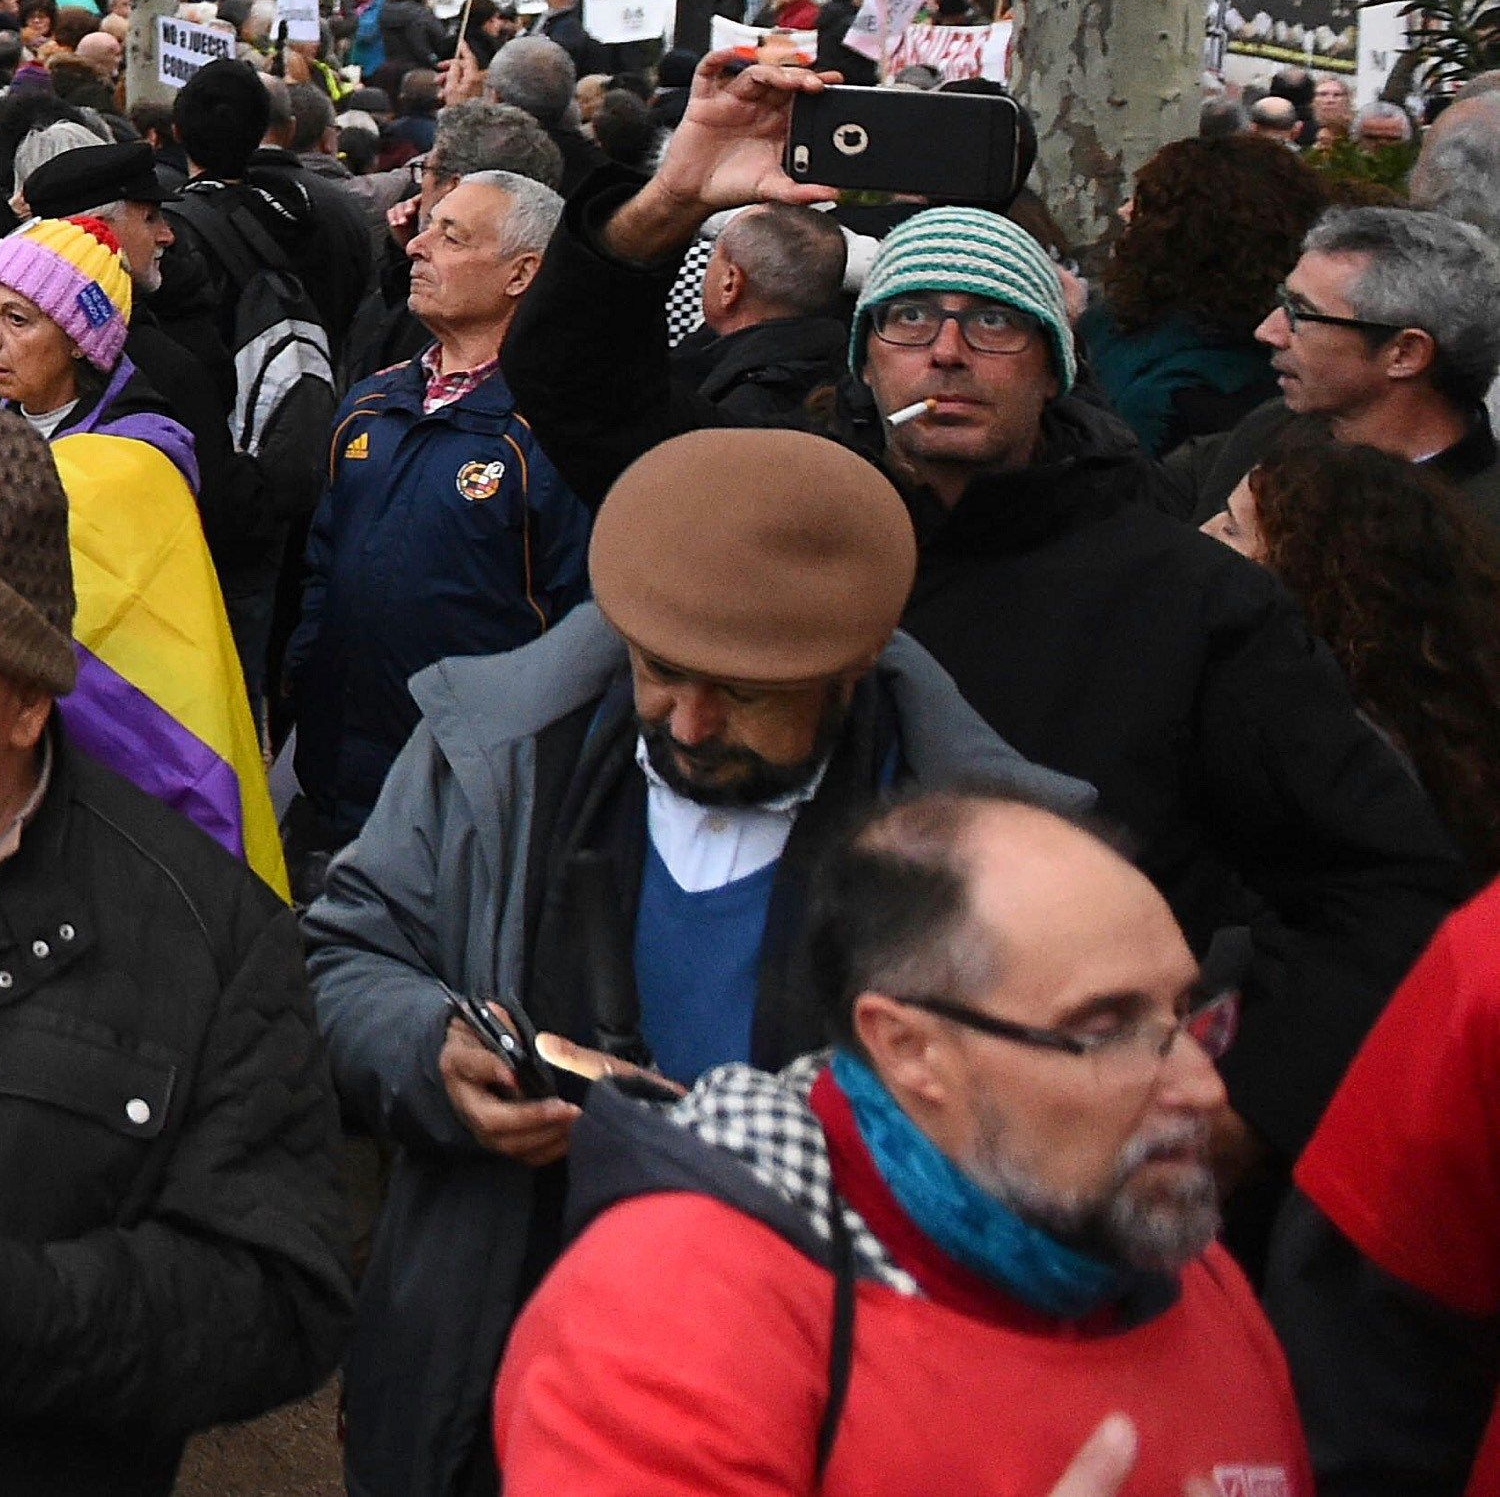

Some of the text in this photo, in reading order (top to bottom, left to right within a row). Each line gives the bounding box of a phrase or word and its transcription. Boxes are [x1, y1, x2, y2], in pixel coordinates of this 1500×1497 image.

[162, 22, 229, 59] NO a JUECES
